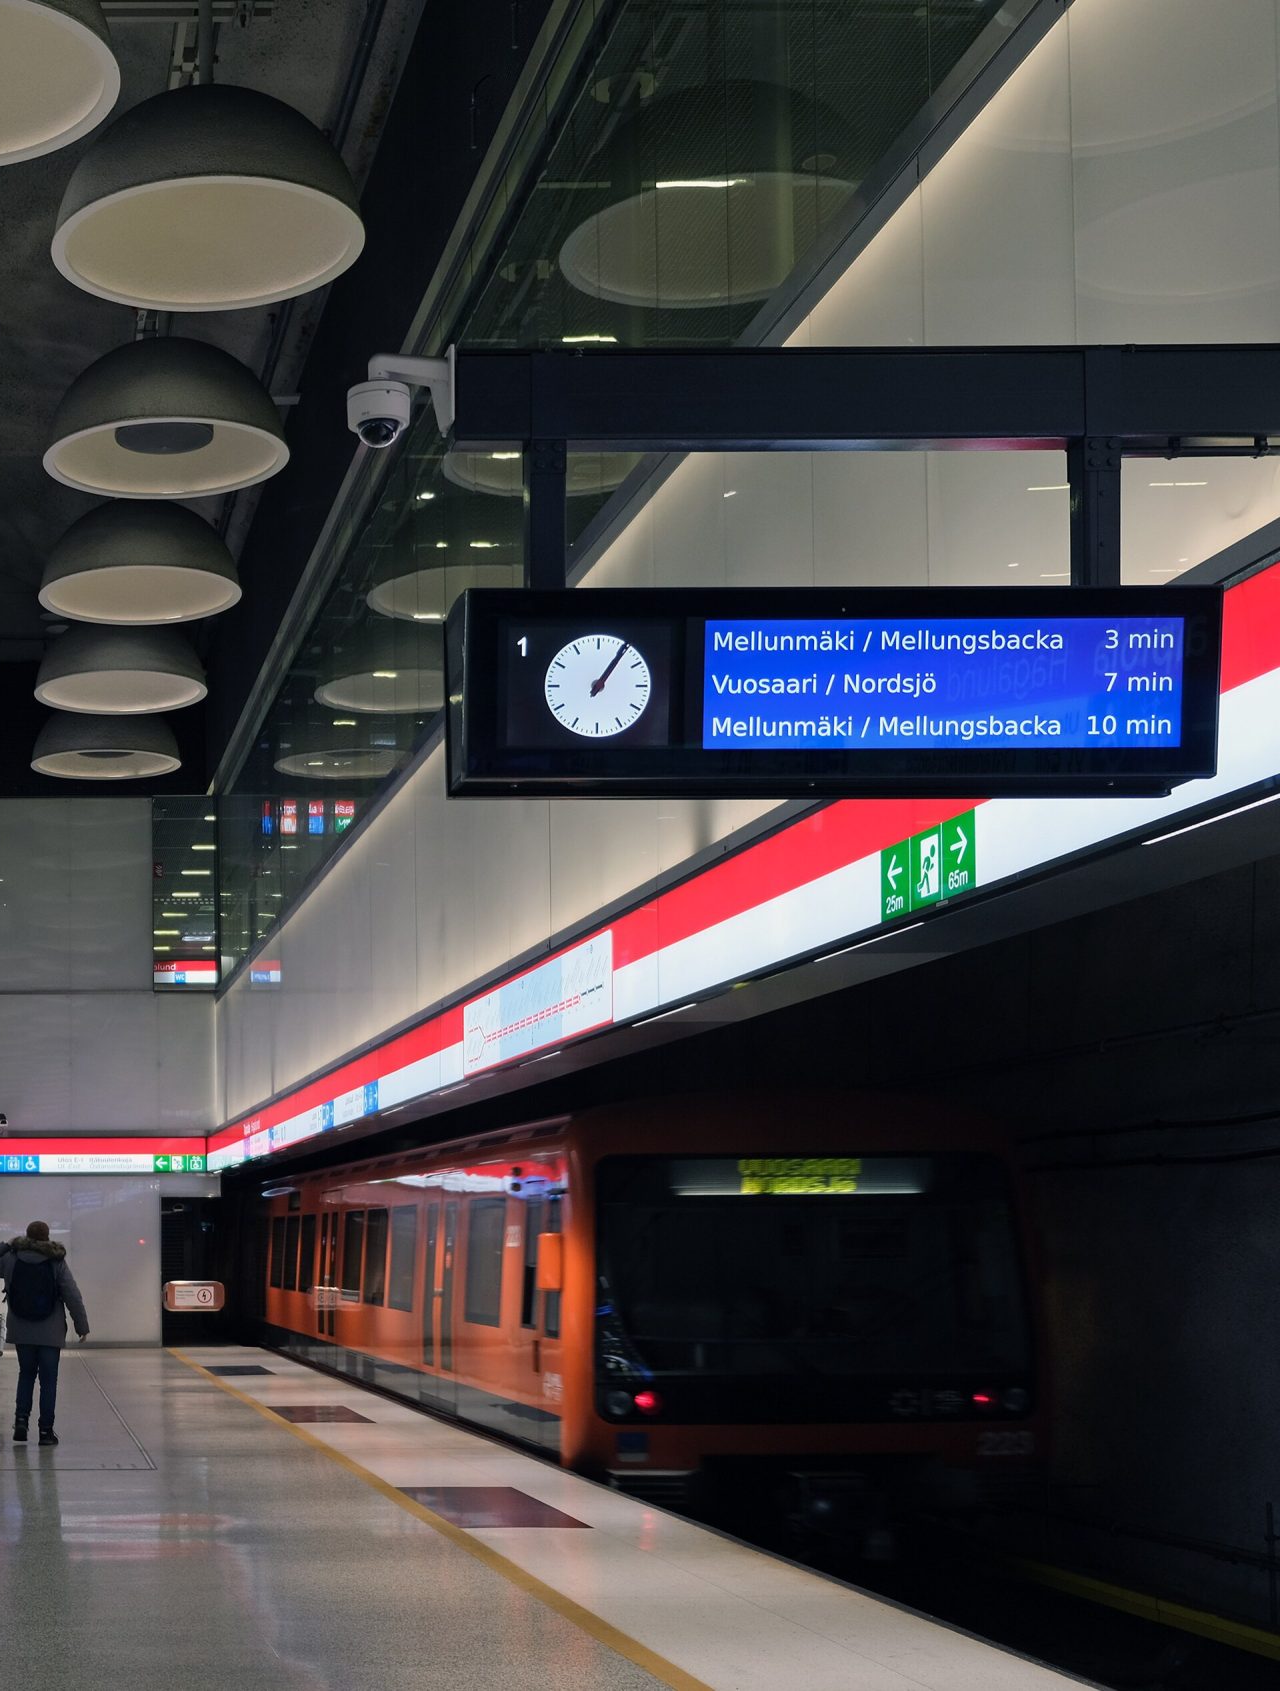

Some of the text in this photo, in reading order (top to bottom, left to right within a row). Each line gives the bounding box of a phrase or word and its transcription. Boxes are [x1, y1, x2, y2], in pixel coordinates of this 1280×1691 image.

[517, 636, 527, 657] 1
[713, 628, 1175, 655] Mellunmäki / Mellungsbacka 3 min
[711, 671, 1173, 698] Vuosaari / Nordsjö 7 min
[711, 715, 853, 737] Mellunmäki
[860, 716, 871, 739] /
[878, 714, 1062, 740] Mellungsbacka
[1086, 714, 1118, 735] 10
[1126, 713, 1172, 735] min
[948, 869, 969, 890] 65m
[885, 894, 904, 914] 25m
